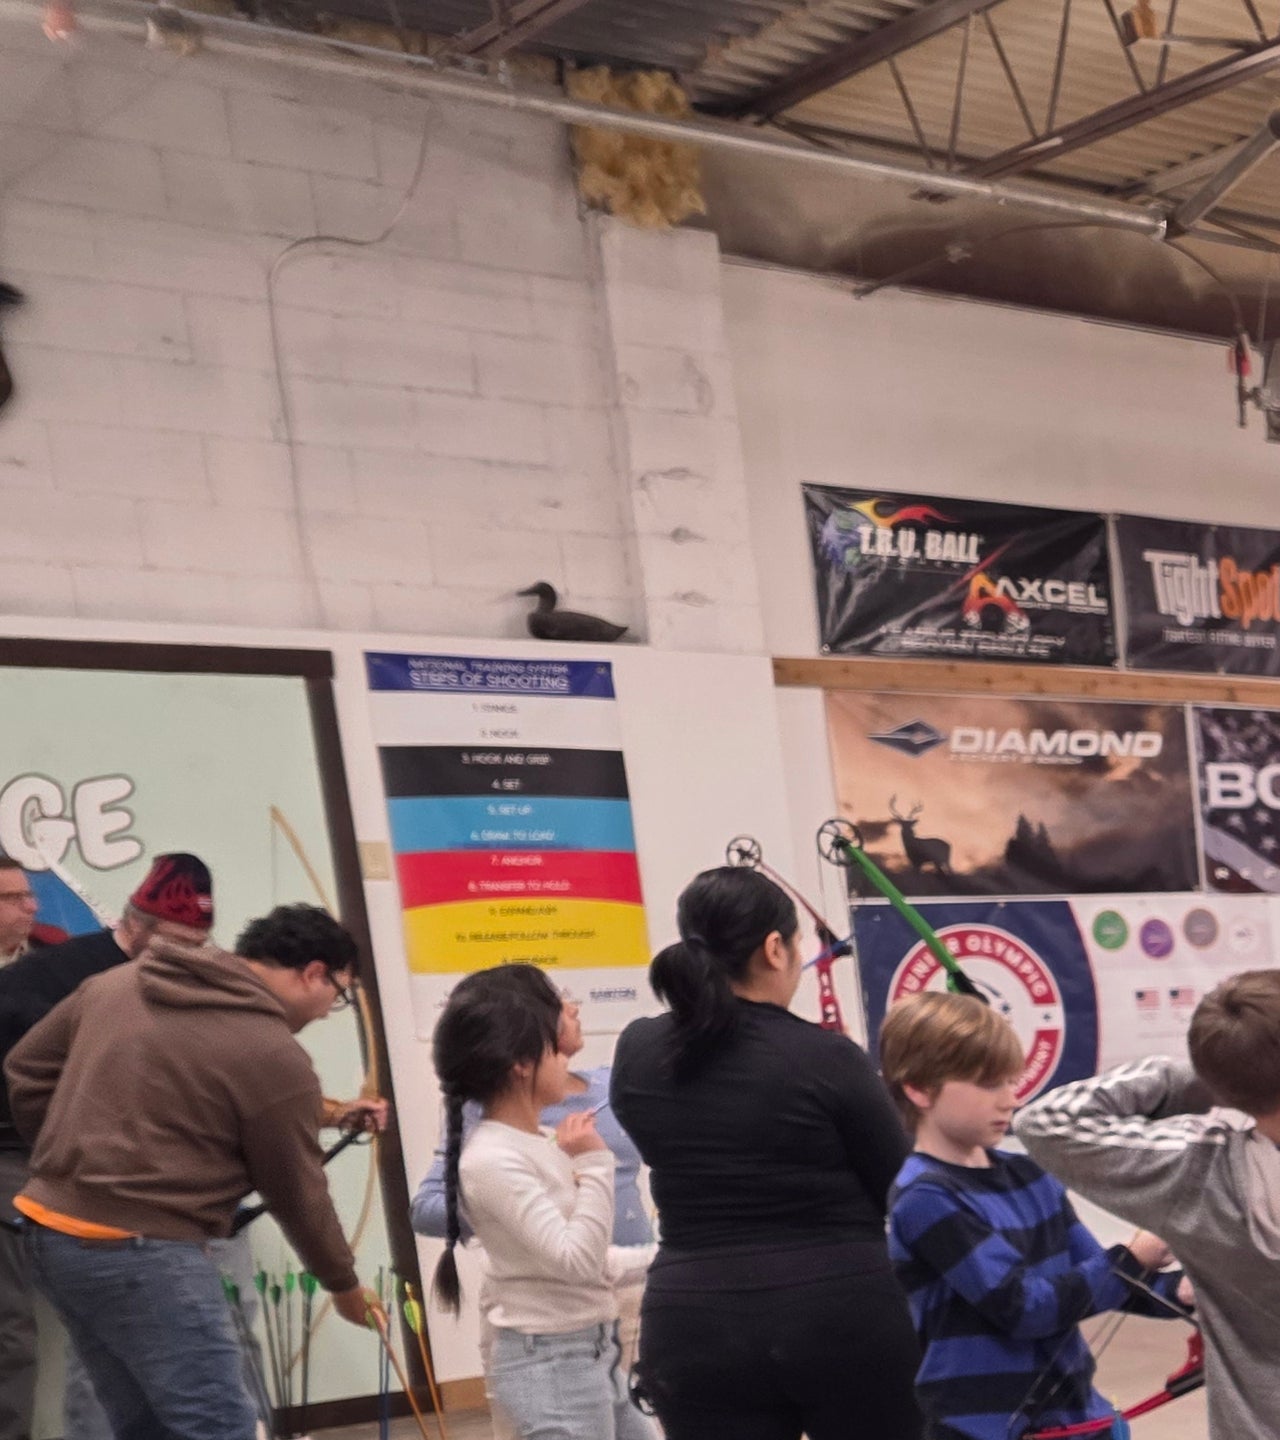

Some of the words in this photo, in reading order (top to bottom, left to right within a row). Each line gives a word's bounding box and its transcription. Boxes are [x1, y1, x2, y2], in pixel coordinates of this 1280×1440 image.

[925, 530, 980, 563] BALL
[996, 576, 1108, 607] AXCEL
[461, 673, 483, 687] OF
[487, 674, 569, 689] SHOOTING
[950, 726, 1163, 758] DIAMOND
[965, 934, 1049, 998] OLYMPIC
